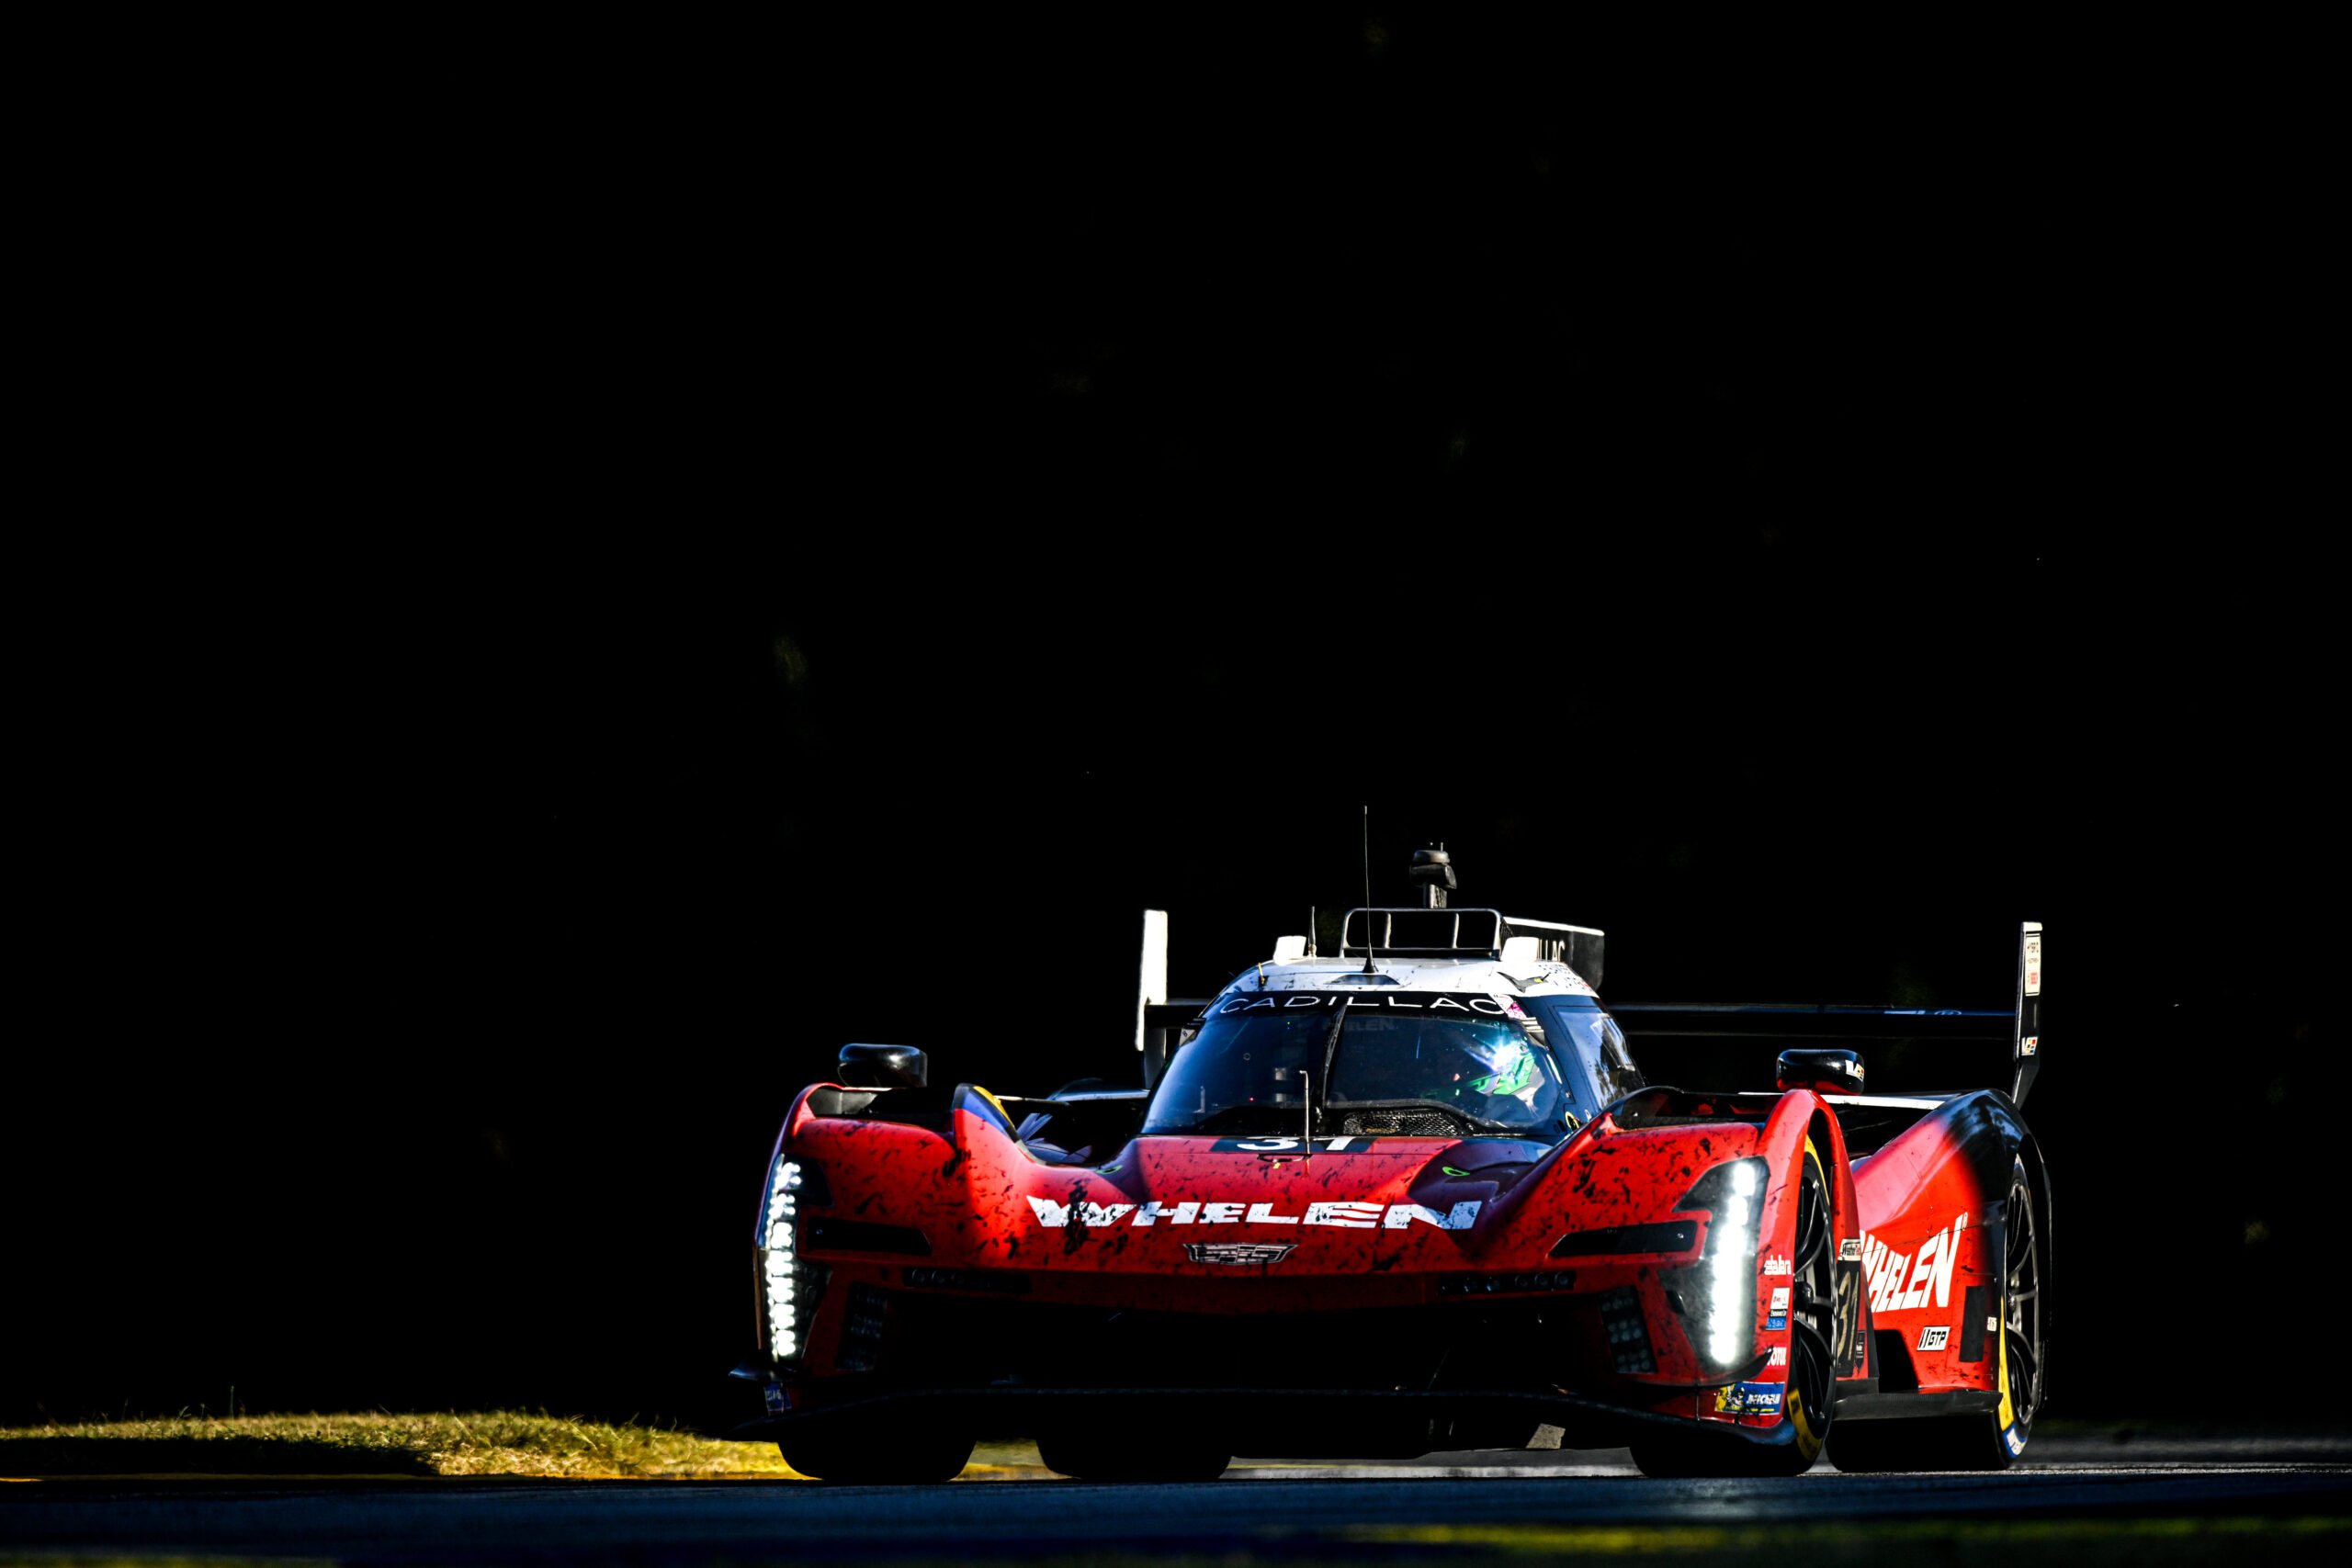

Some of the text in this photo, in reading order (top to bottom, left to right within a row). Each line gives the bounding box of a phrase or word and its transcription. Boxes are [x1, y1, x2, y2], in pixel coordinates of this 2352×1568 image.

[1220, 995, 1505, 1015] CADILLAC
[1237, 1135, 1357, 1151] 31
[1026, 1195, 1483, 1229] WHELEN
[1838, 1269, 1860, 1361] 31
[1928, 1330, 1948, 1347] GTP
[1767, 1346, 1788, 1366] OTUL
